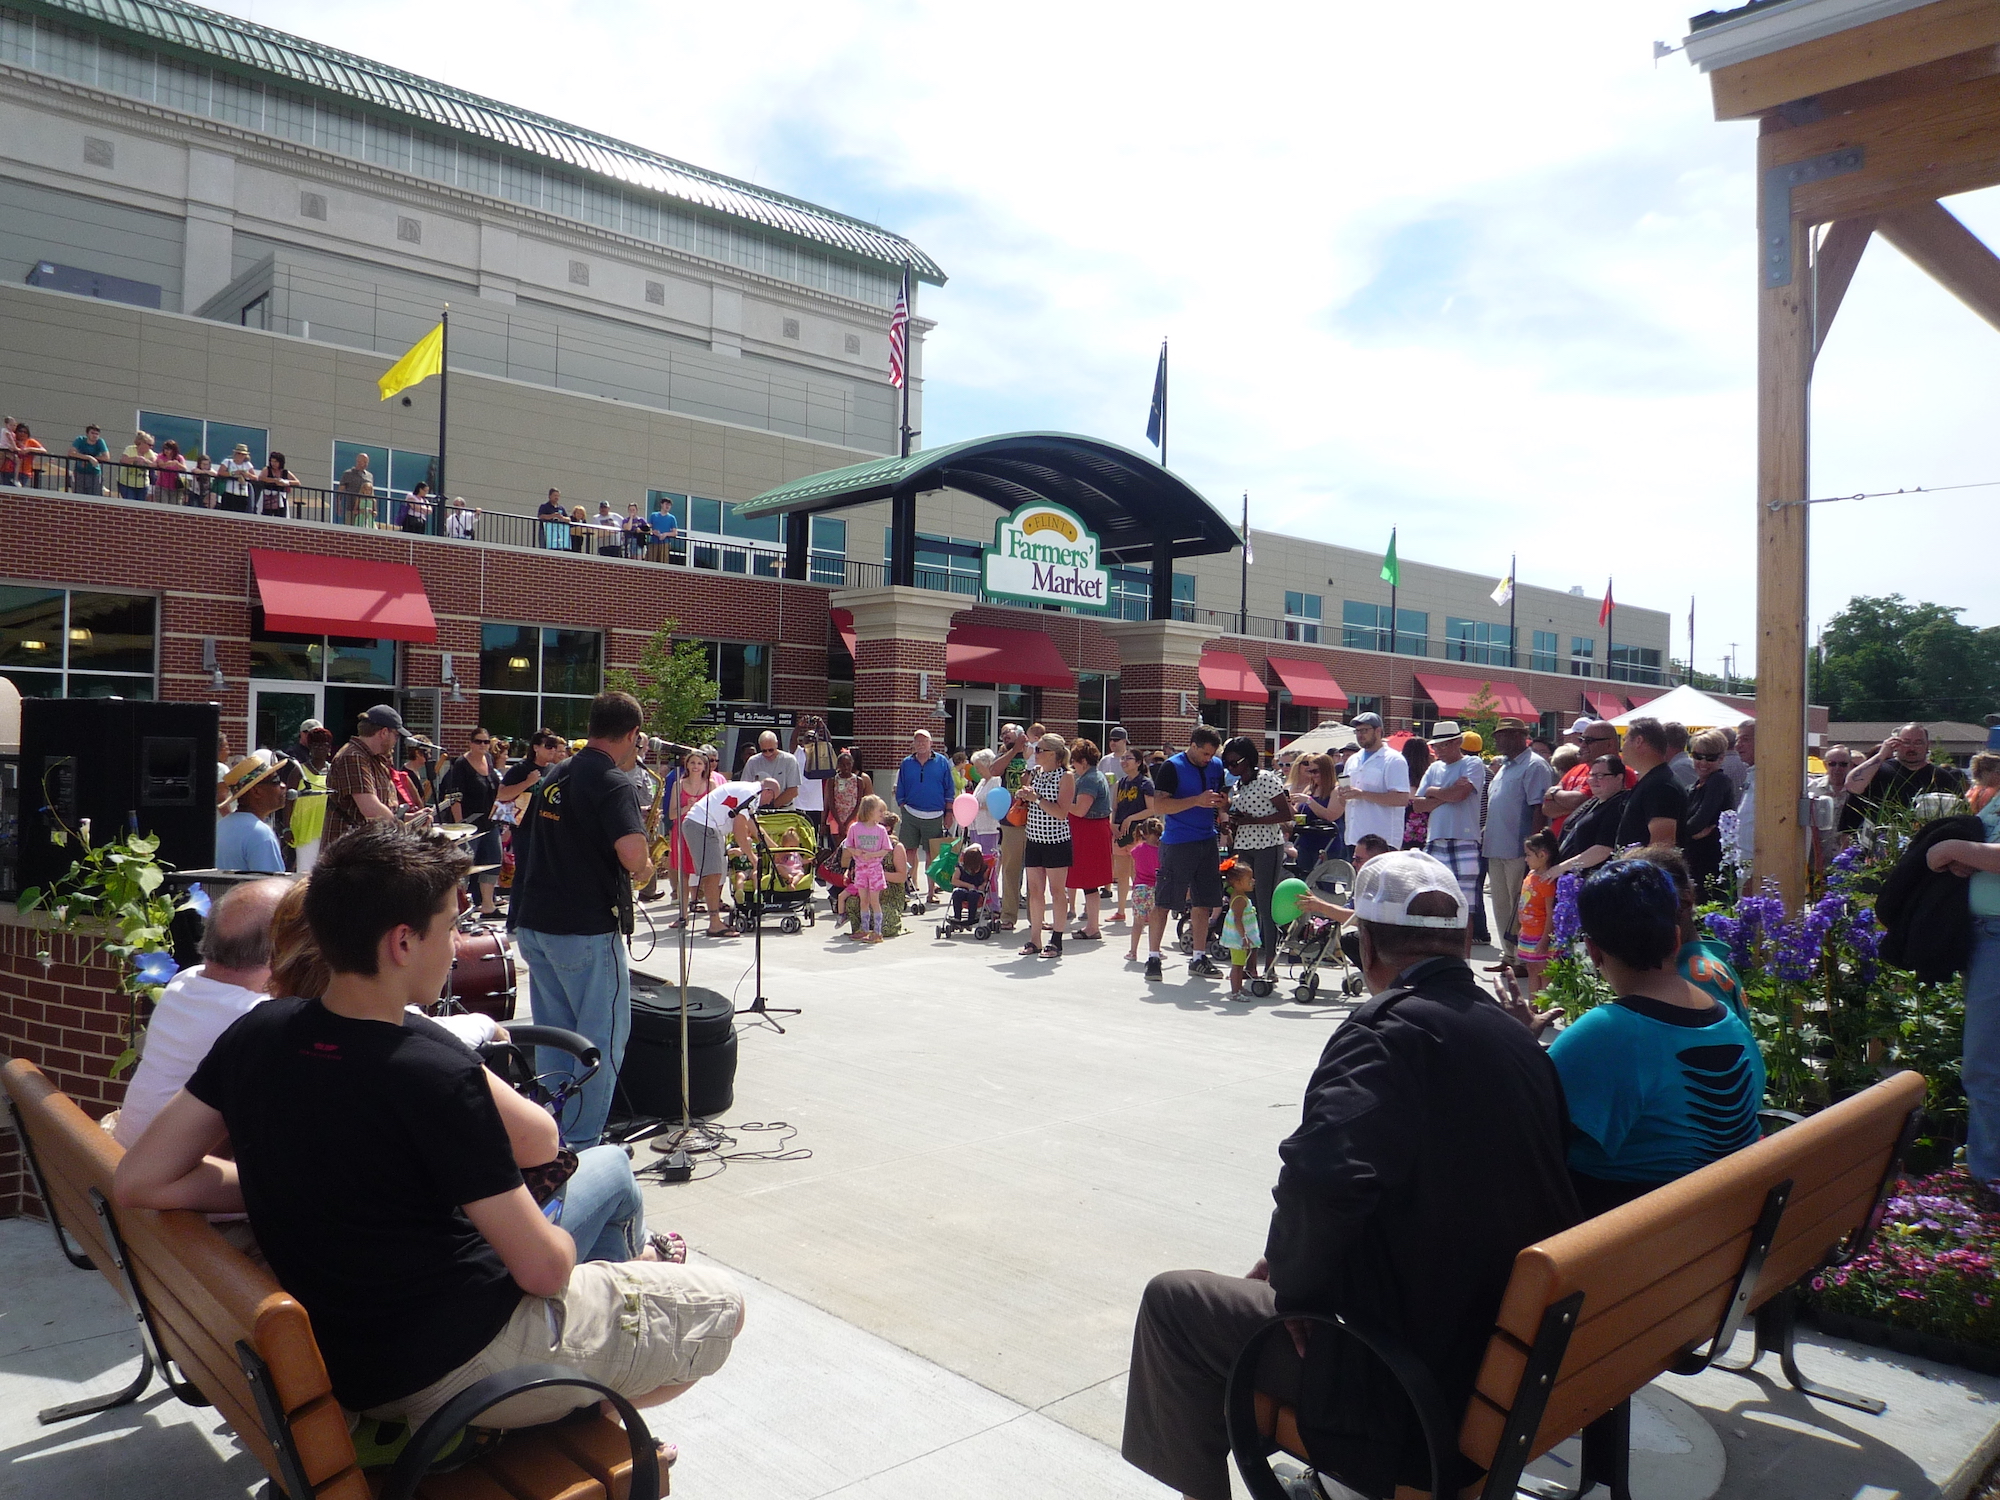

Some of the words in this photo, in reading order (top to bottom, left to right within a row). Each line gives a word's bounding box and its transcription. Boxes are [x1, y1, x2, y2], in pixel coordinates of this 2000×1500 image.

[1034, 516, 1067, 532] FLINT
[1008, 529, 1094, 568] Farmers'
[1032, 562, 1102, 599] Market
